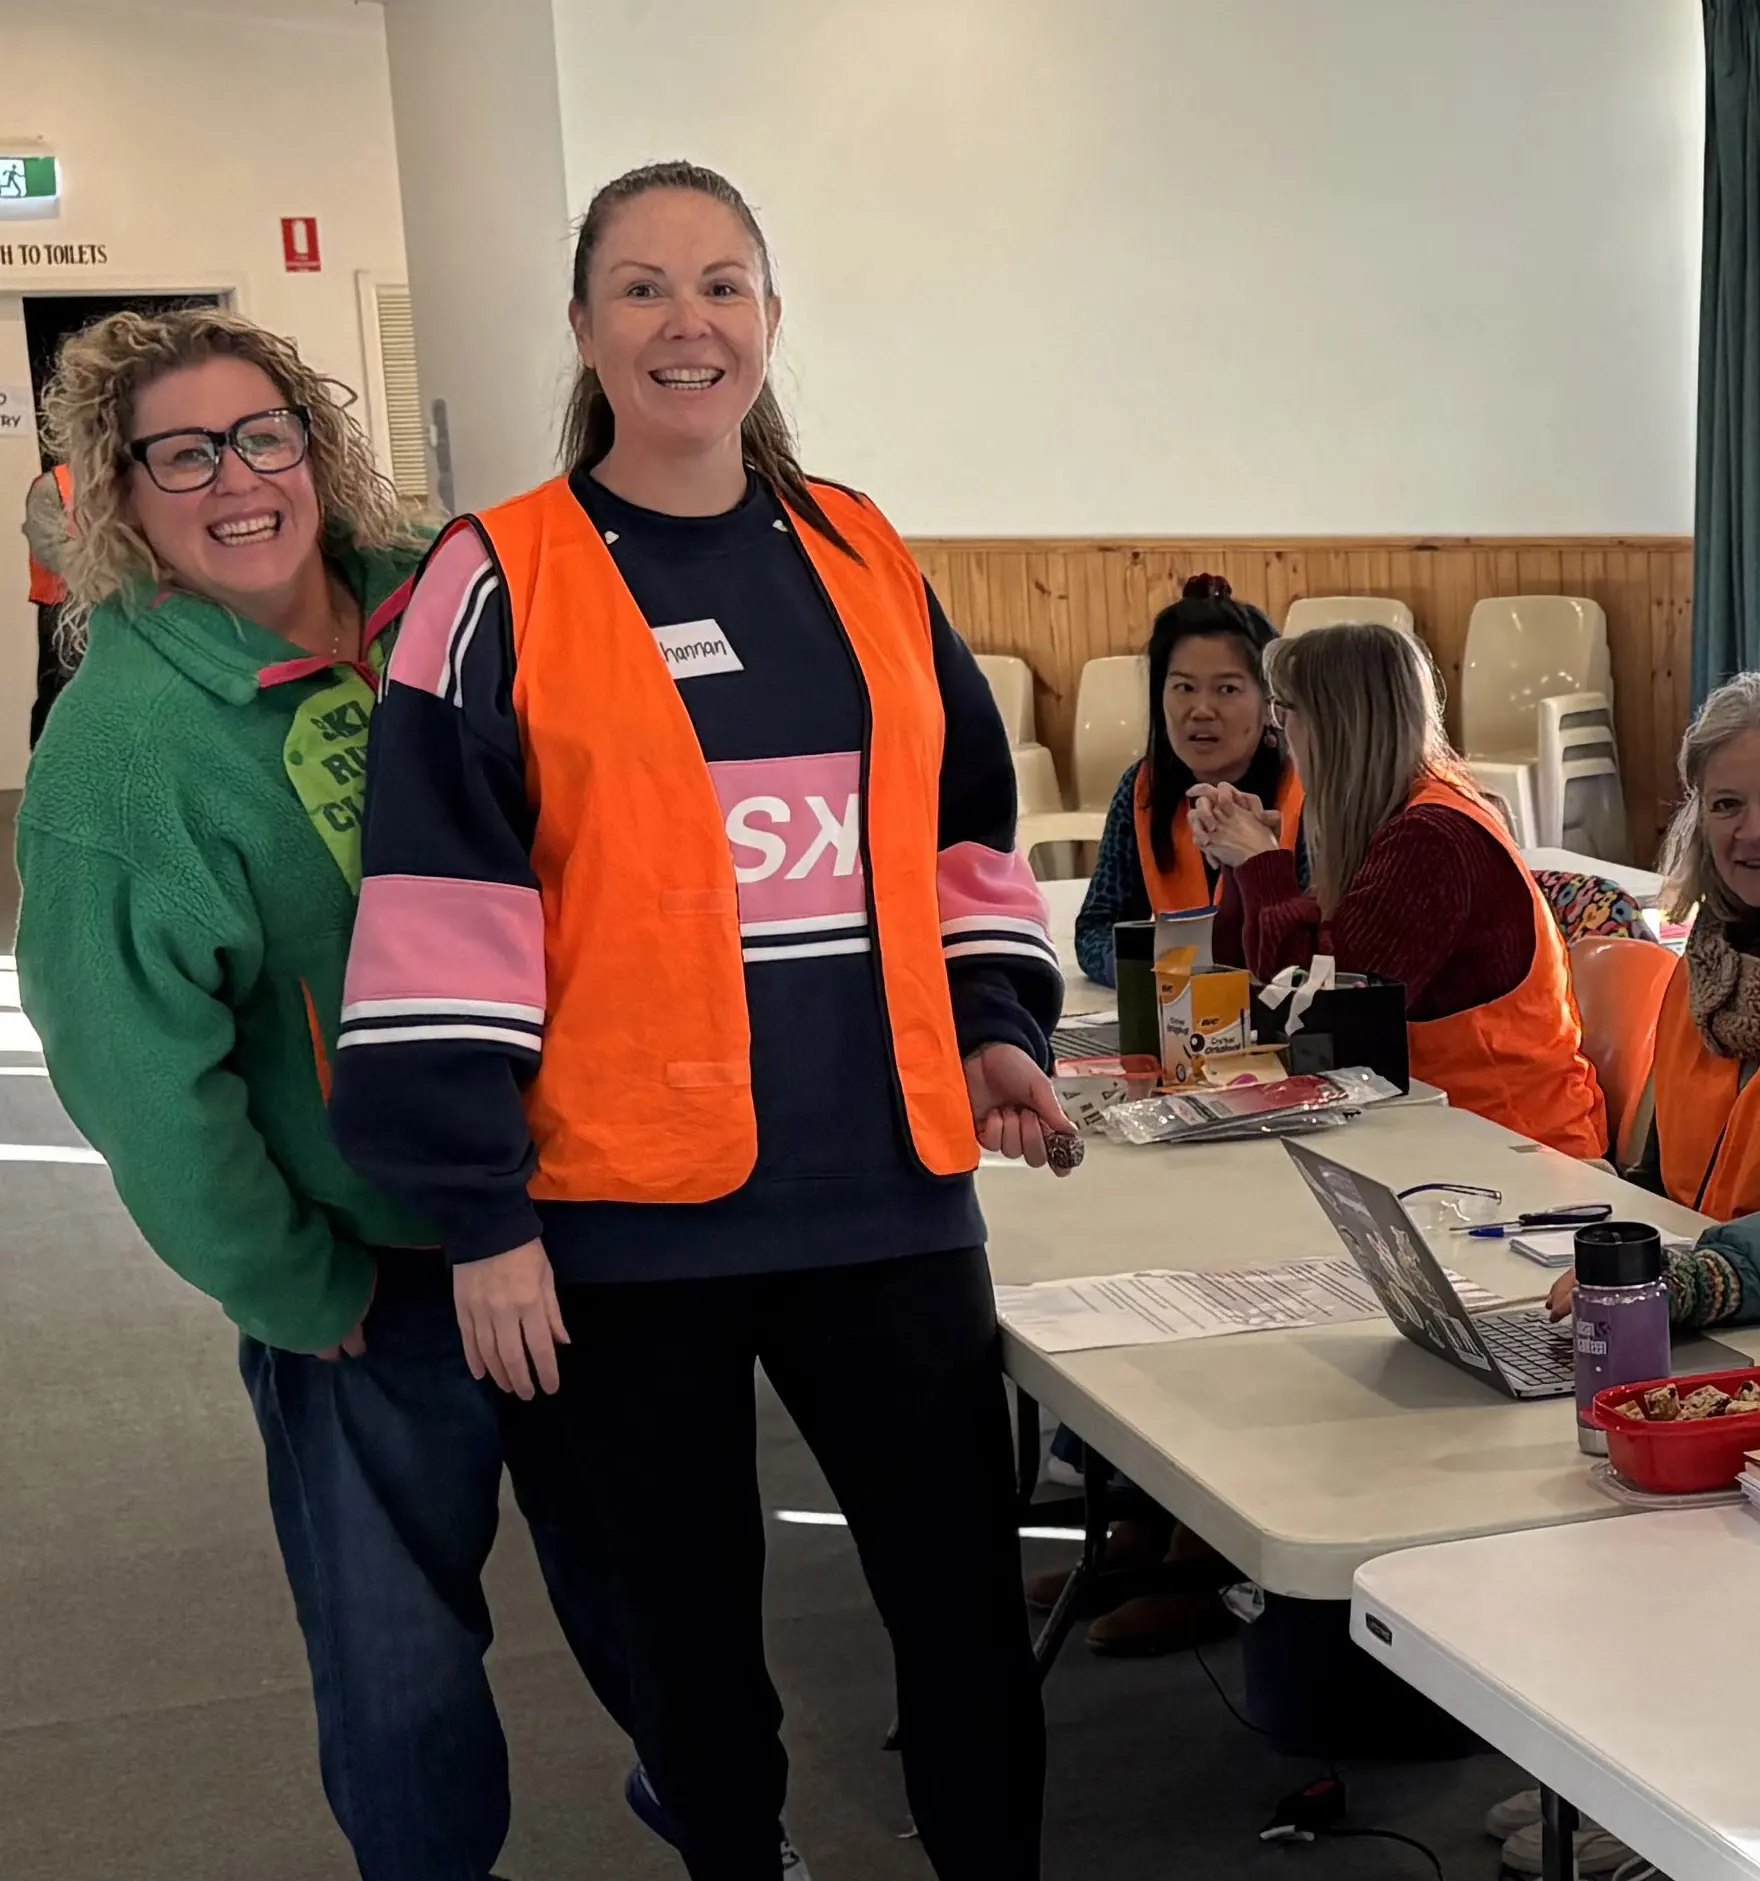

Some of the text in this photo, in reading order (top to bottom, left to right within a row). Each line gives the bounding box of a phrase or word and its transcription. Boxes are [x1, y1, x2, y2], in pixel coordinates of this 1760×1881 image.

[18, 244, 40, 265] TO
[44, 244, 108, 265] TOILETS
[659, 639, 728, 663] hannan
